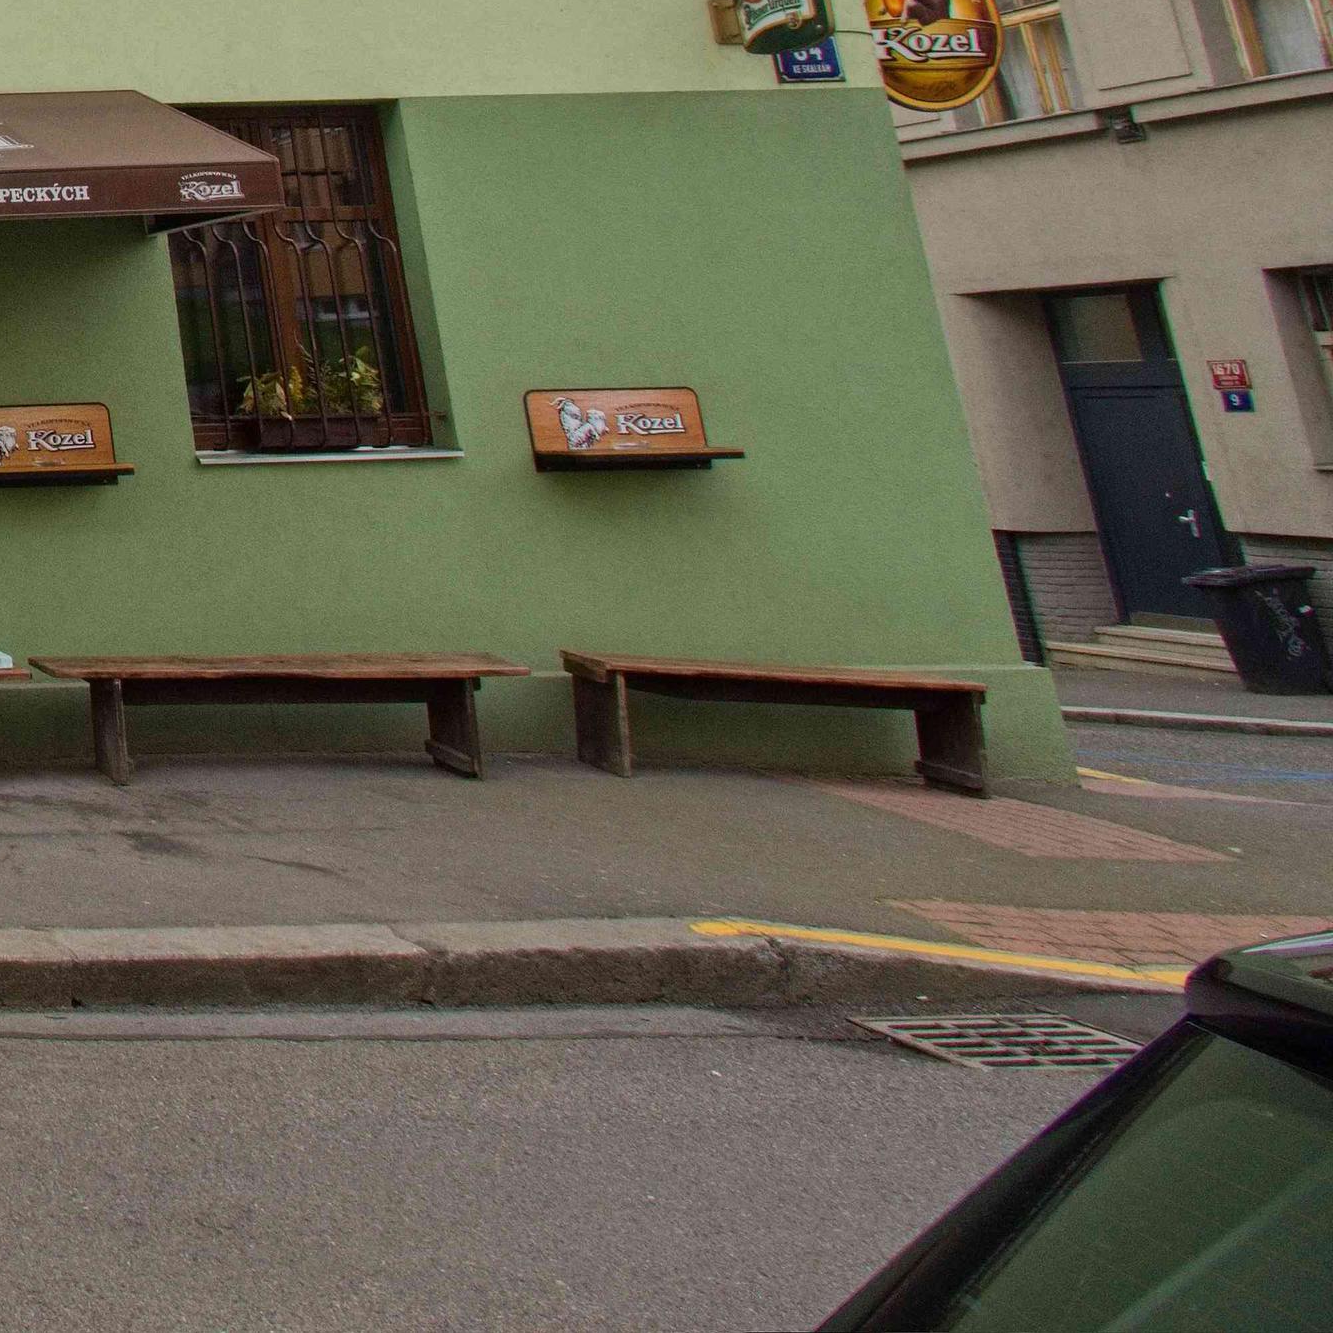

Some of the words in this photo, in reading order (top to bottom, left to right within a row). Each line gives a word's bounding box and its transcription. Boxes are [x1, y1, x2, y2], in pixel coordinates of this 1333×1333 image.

[871, 26, 988, 63] Kozel
[177, 179, 246, 203] Kozel
[1229, 393, 1239, 406] 9
[614, 410, 686, 436] Kozel
[25, 428, 96, 452] Kozel
